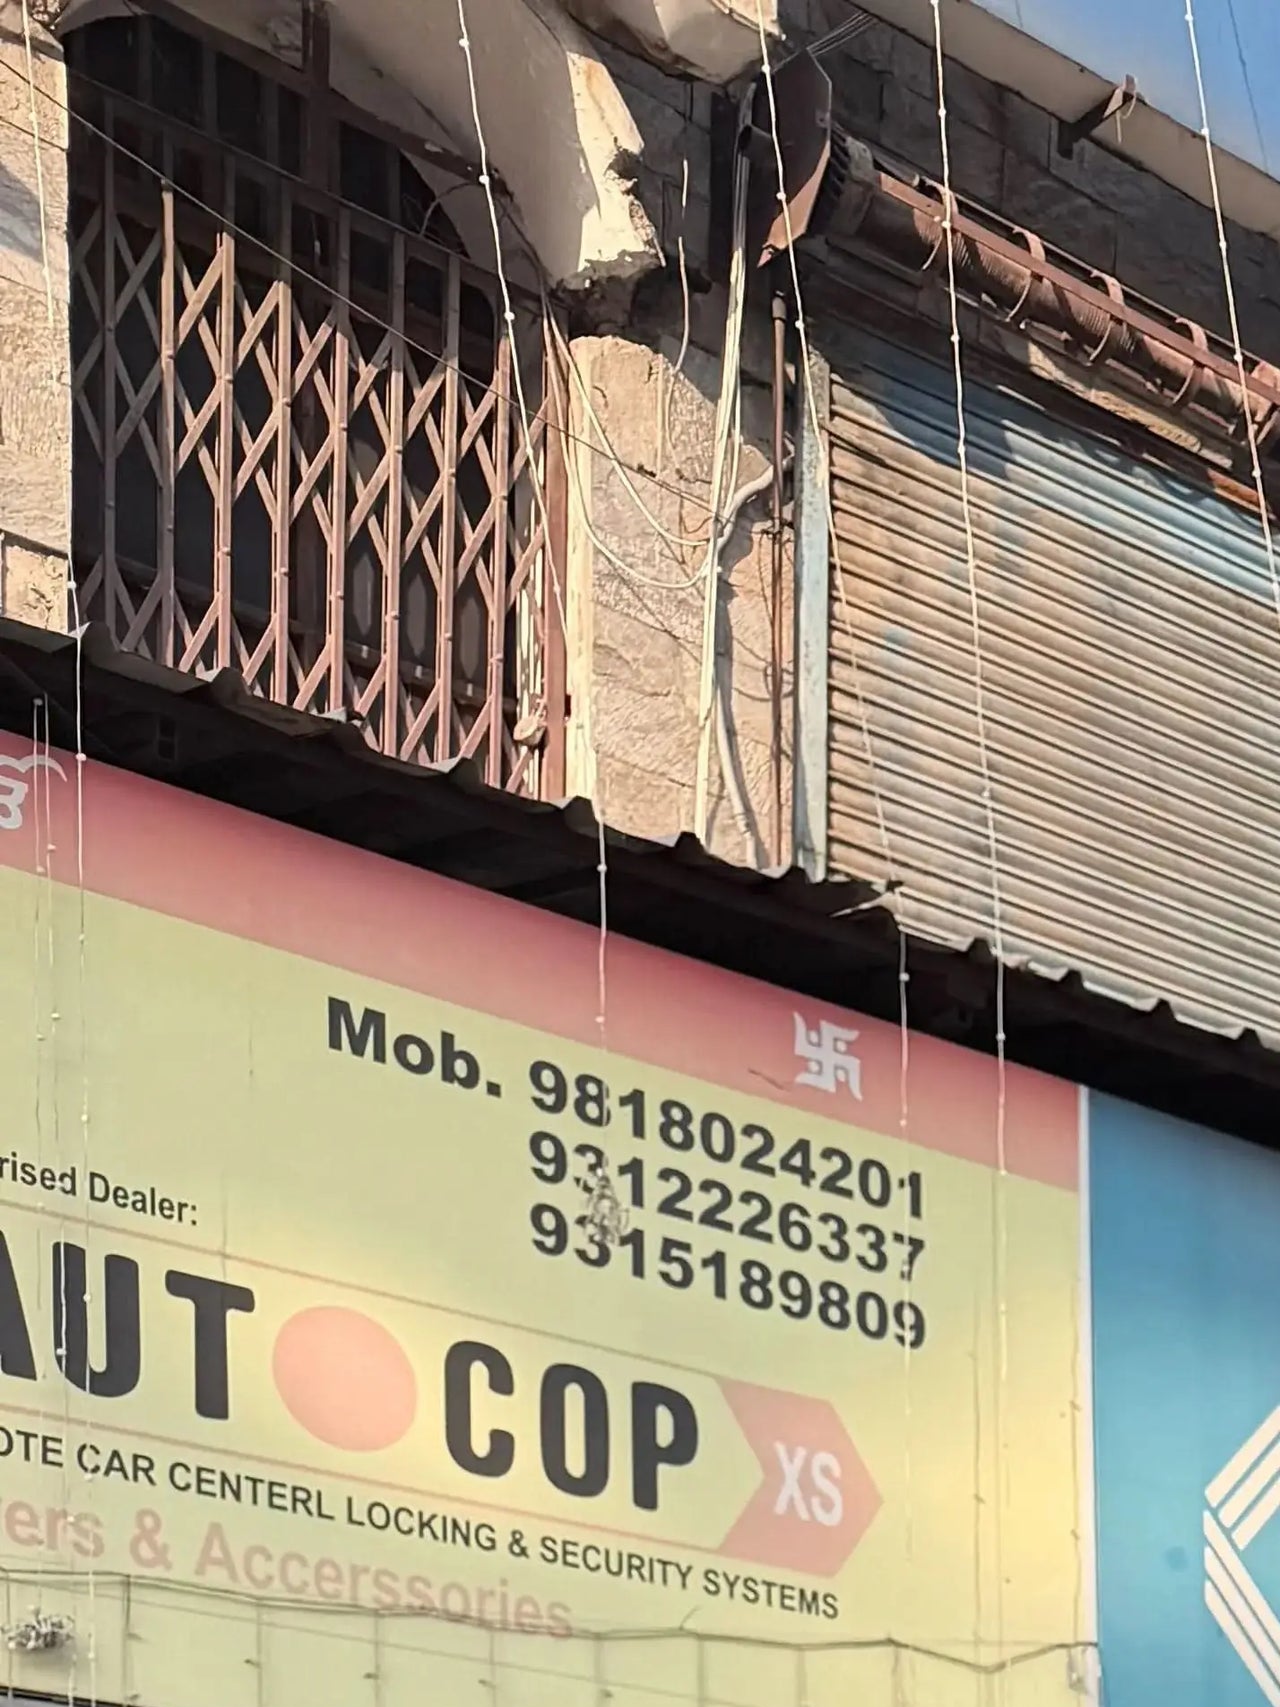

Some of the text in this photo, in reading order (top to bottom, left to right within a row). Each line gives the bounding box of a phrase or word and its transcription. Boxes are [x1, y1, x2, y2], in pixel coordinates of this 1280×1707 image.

[327, 996, 924, 1219] Mob. 9818024201
[88, 1172, 199, 1227] Dealer:
[529, 1130, 926, 1282] 9312226337
[529, 1202, 927, 1351] 9315189809
[444, 1340, 699, 1511] COP
[773, 1441, 844, 1527] XS
[77, 1442, 157, 1487] CAR
[168, 1462, 336, 1521] CENTERL
[346, 1496, 497, 1552] LOCKING
[508, 1530, 529, 1559] &
[540, 1536, 693, 1590] SECURITY
[703, 1569, 839, 1619] SYSTEMS
[129, 1507, 174, 1571] &
